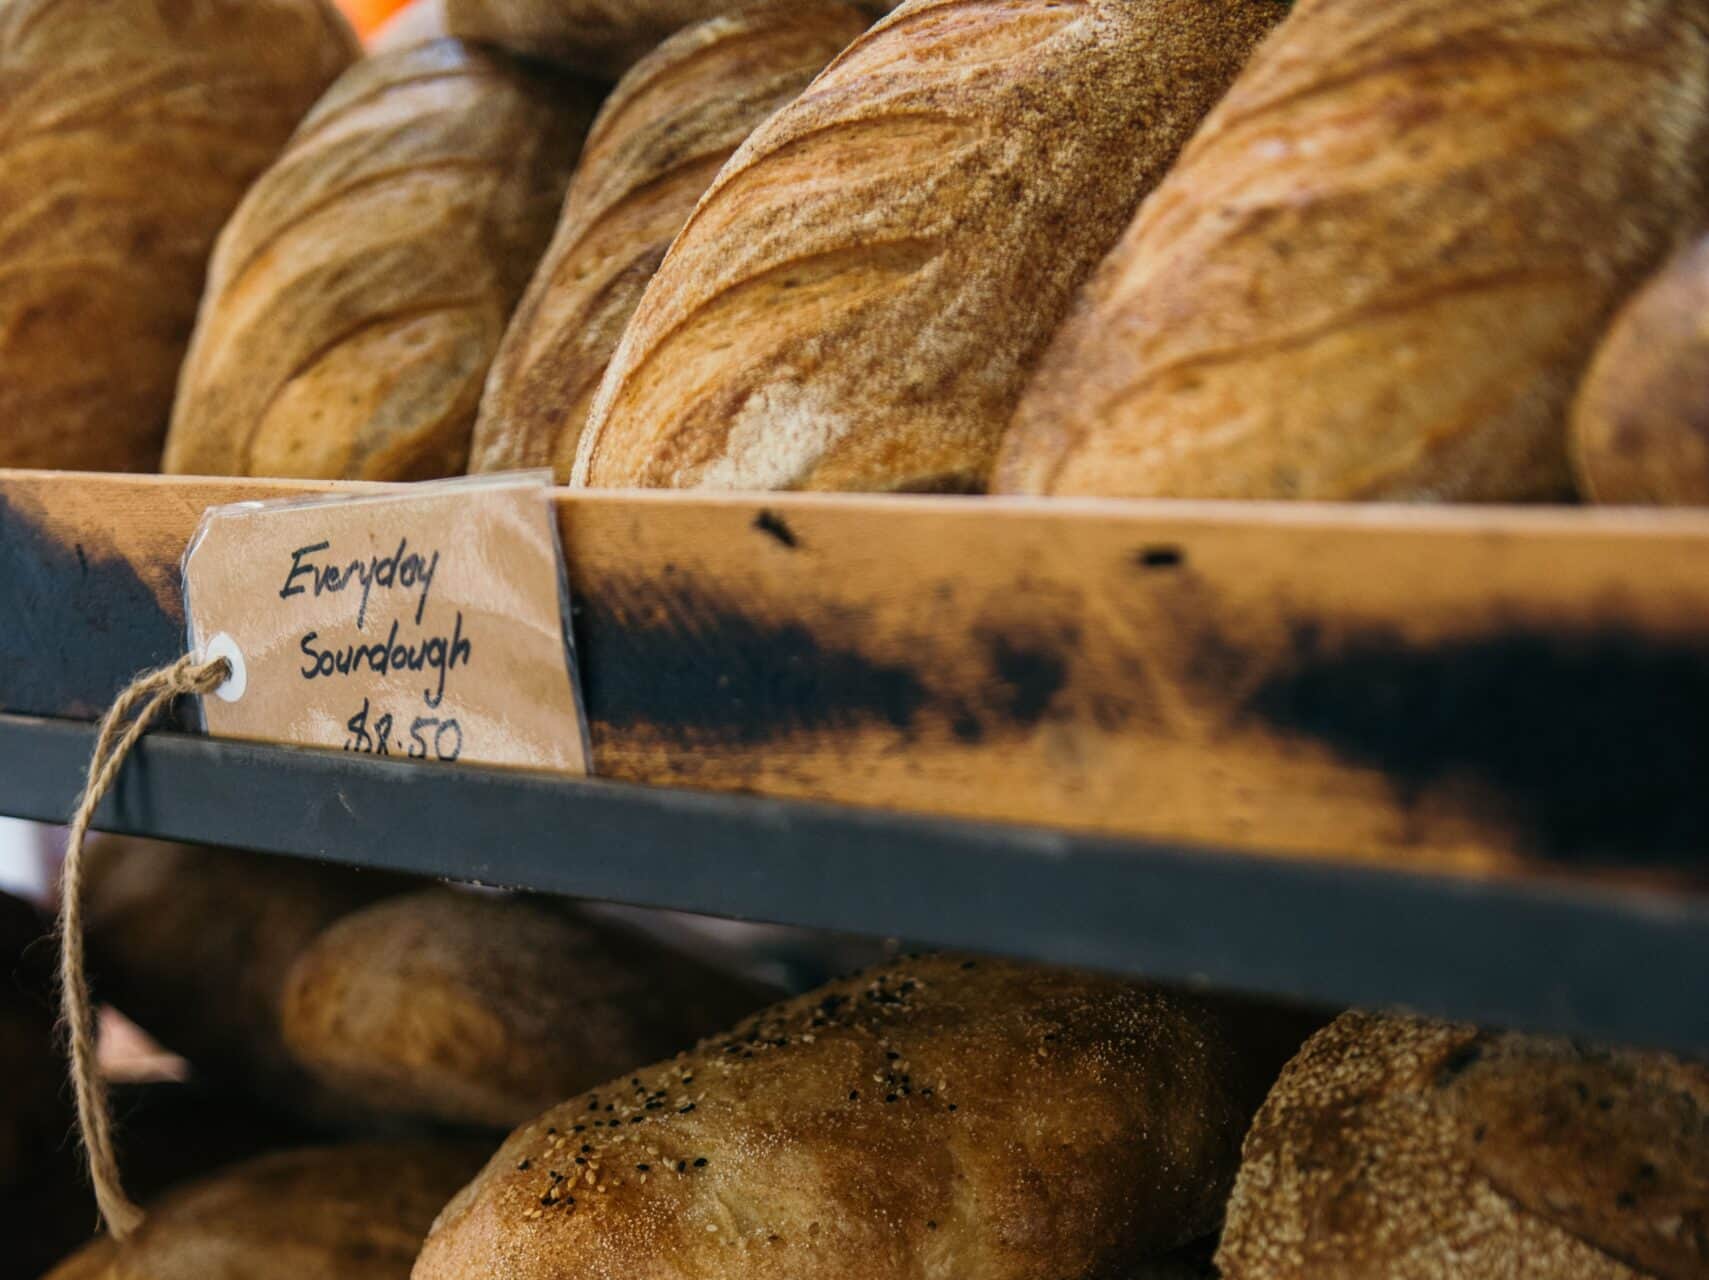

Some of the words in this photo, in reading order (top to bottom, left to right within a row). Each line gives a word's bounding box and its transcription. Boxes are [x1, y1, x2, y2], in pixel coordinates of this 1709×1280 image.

[279, 538, 439, 629] Everyday
[300, 611, 471, 709] Sourdough
[343, 697, 463, 762] $8.50
